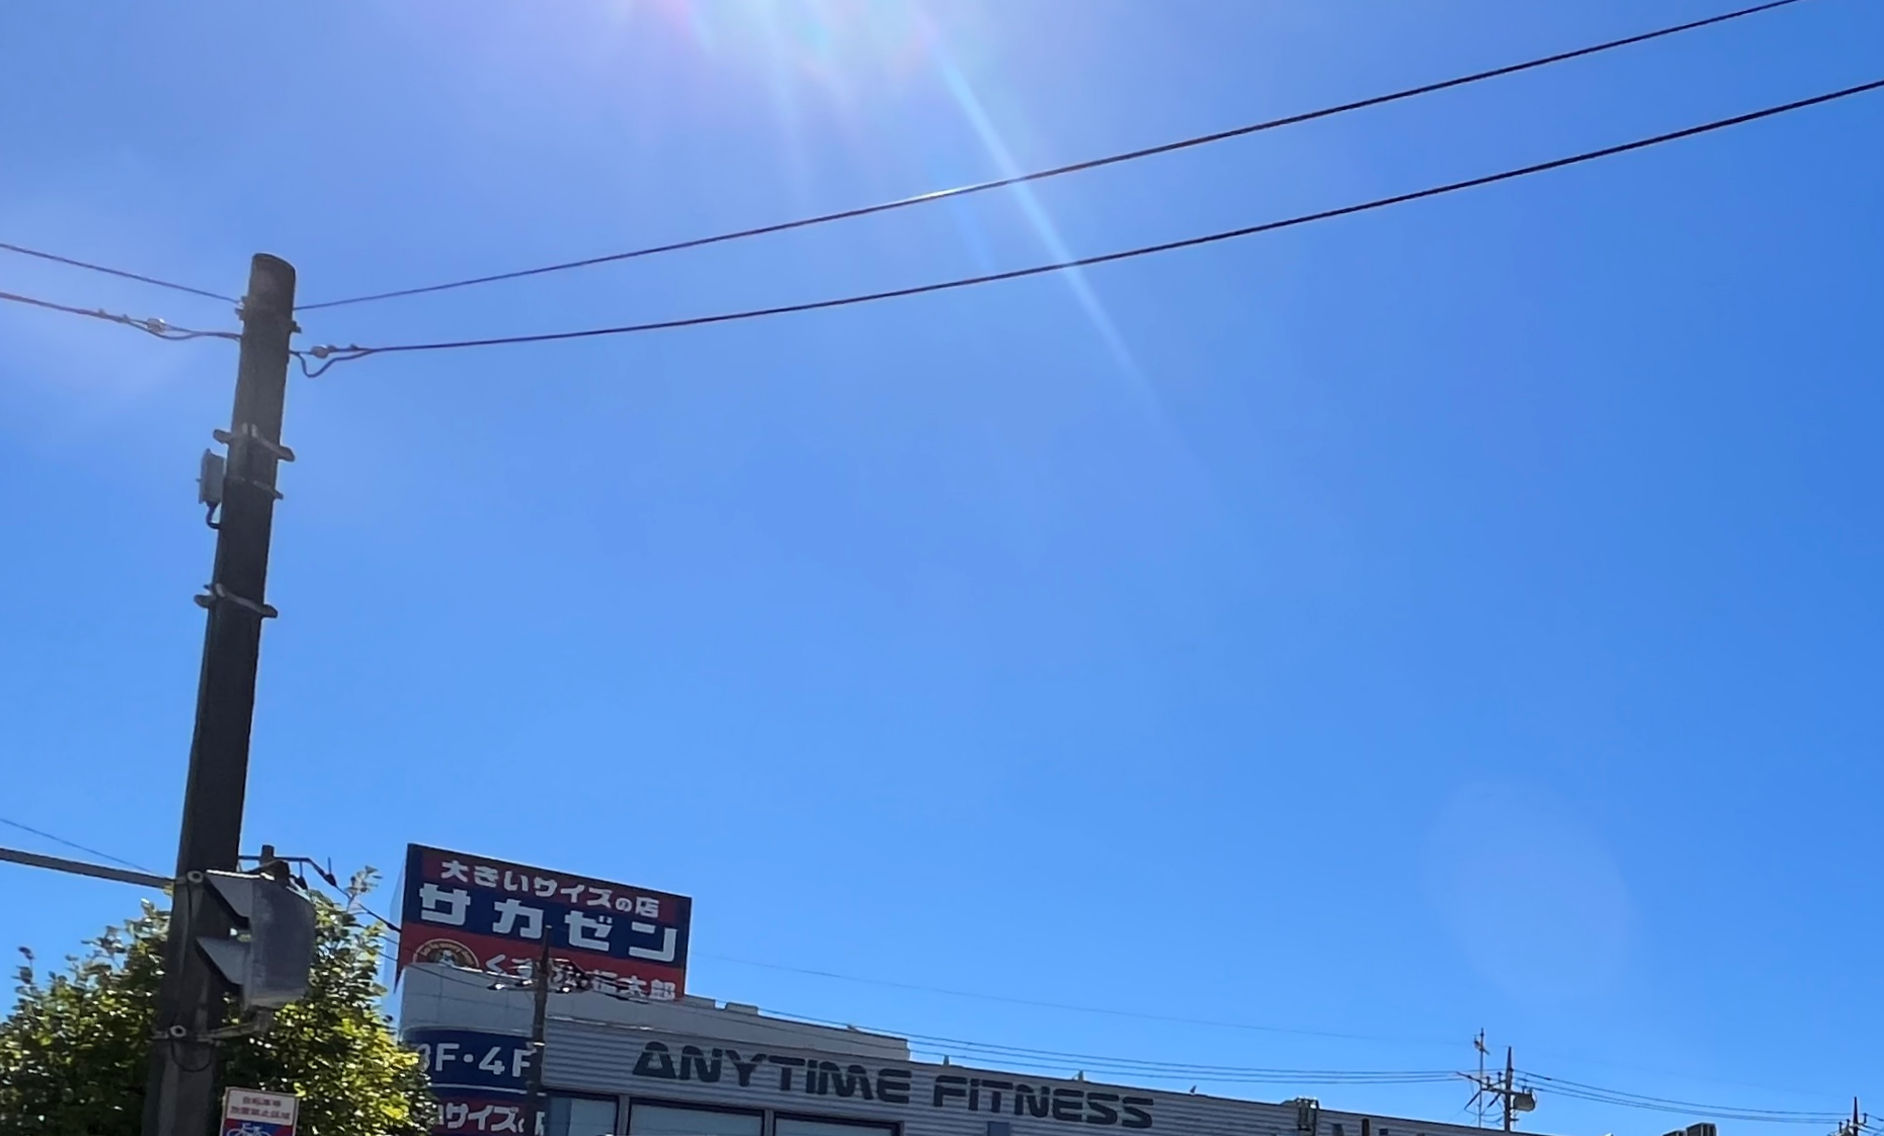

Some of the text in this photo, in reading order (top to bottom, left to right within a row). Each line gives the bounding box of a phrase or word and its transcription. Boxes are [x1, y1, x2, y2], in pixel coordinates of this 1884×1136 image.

[419, 883, 679, 964] サカゼン
[441, 860, 660, 918] 大きいサイズの店
[633, 1041, 1154, 1129] ANYTIME FITNESS
